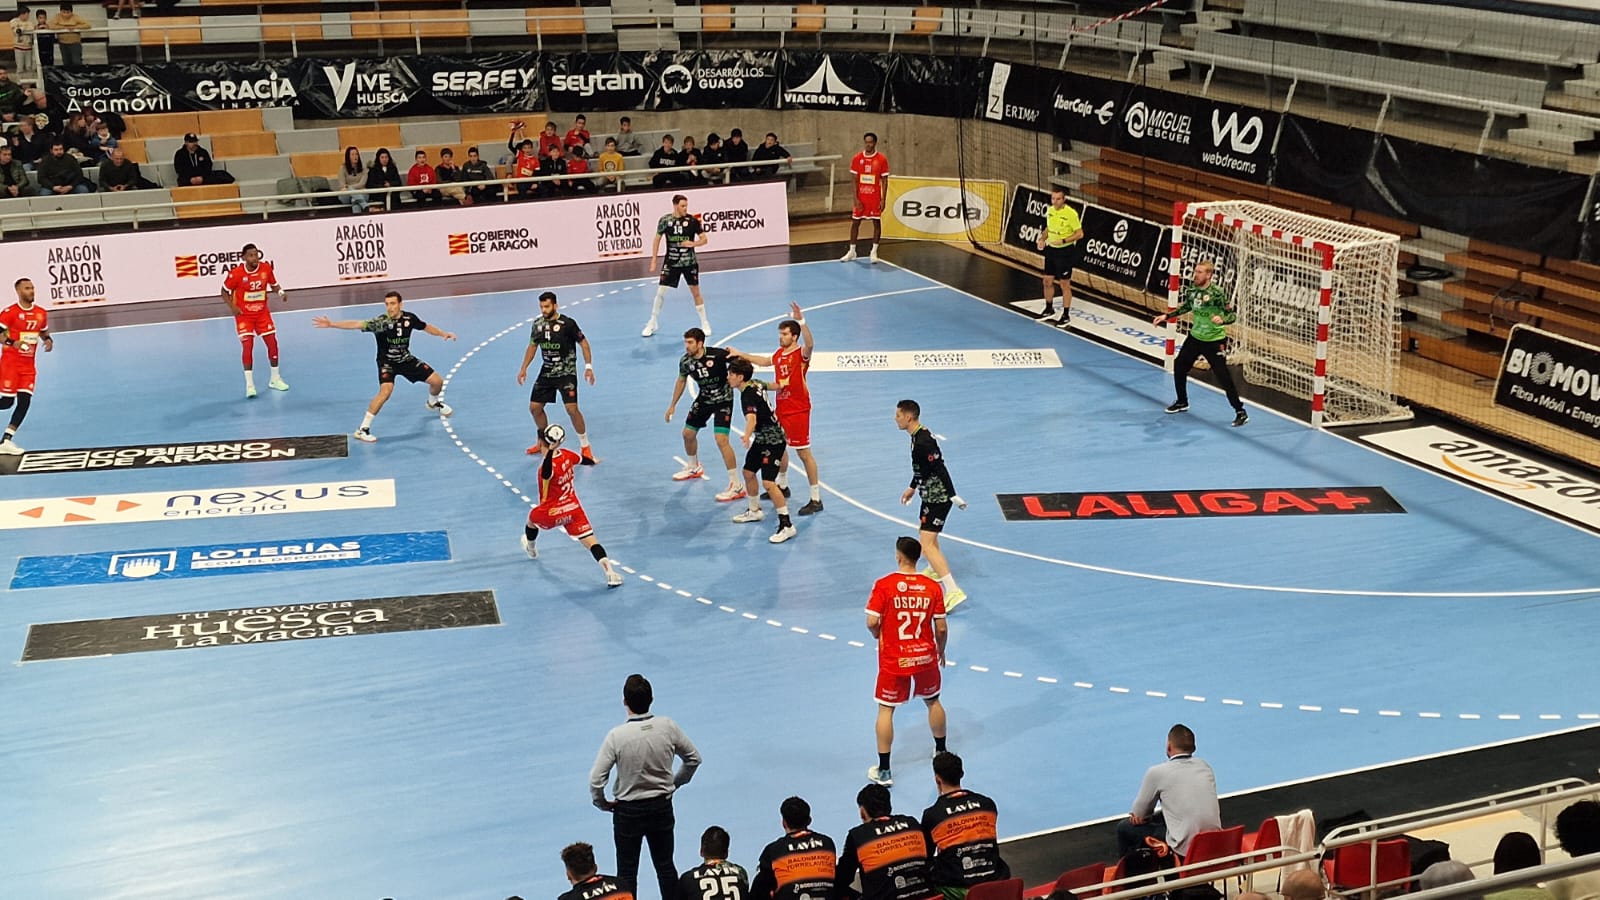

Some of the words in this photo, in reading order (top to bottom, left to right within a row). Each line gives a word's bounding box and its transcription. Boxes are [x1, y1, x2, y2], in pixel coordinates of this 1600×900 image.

[432, 68, 535, 91] SERFEY
[698, 67, 764, 78] DESARROLLOS
[66, 86, 111, 97] Grupo
[698, 77, 744, 90] GUASO
[357, 92, 409, 104] HUESCA
[784, 93, 839, 106] VIACRON,
[842, 96, 866, 107] S.A.
[1150, 108, 1192, 136] MIGUEL
[1147, 126, 1191, 145] ESCUER
[1202, 150, 1257, 175] webdreams
[702, 208, 757, 223] GOBIERNO
[901, 200, 982, 220] Bada
[469, 228, 530, 242] GOBIERNO
[596, 217, 642, 240] SABOR
[703, 222, 718, 233] DE
[336, 240, 386, 263] SABOR
[470, 243, 486, 254] DE
[598, 239, 608, 252] DE
[611, 236, 643, 251] VERDAD
[198, 249, 265, 265] GOBIERO
[1086, 238, 1142, 267] escanero
[49, 262, 104, 286] SABOR
[199, 265, 217, 276] DE
[338, 261, 350, 276] DE
[352, 259, 388, 274] VERDAD
[51, 285, 64, 300] DE
[66, 283, 105, 298] VERDAD
[253, 281, 262, 290] 32
[26, 320, 37, 330] 77
[696, 367, 710, 378] 15
[1510, 384, 1534, 402] Fibra
[1538, 394, 1566, 413] Móvil
[88, 442, 271, 458] GOBIERNO
[87, 457, 133, 468] DE
[166, 485, 369, 508] nexus
[192, 541, 360, 561] LOTERÍAS
[272, 553, 343, 562] DEPORTE
[893, 596, 930, 609] ÓSCAR
[897, 611, 926, 640] 27
[945, 799, 981, 815] LAVÍN
[874, 821, 909, 836] LAVÍN
[788, 838, 823, 851] LAVÍN
[582, 882, 618, 900] LAVÍN
[700, 876, 741, 900] 25
